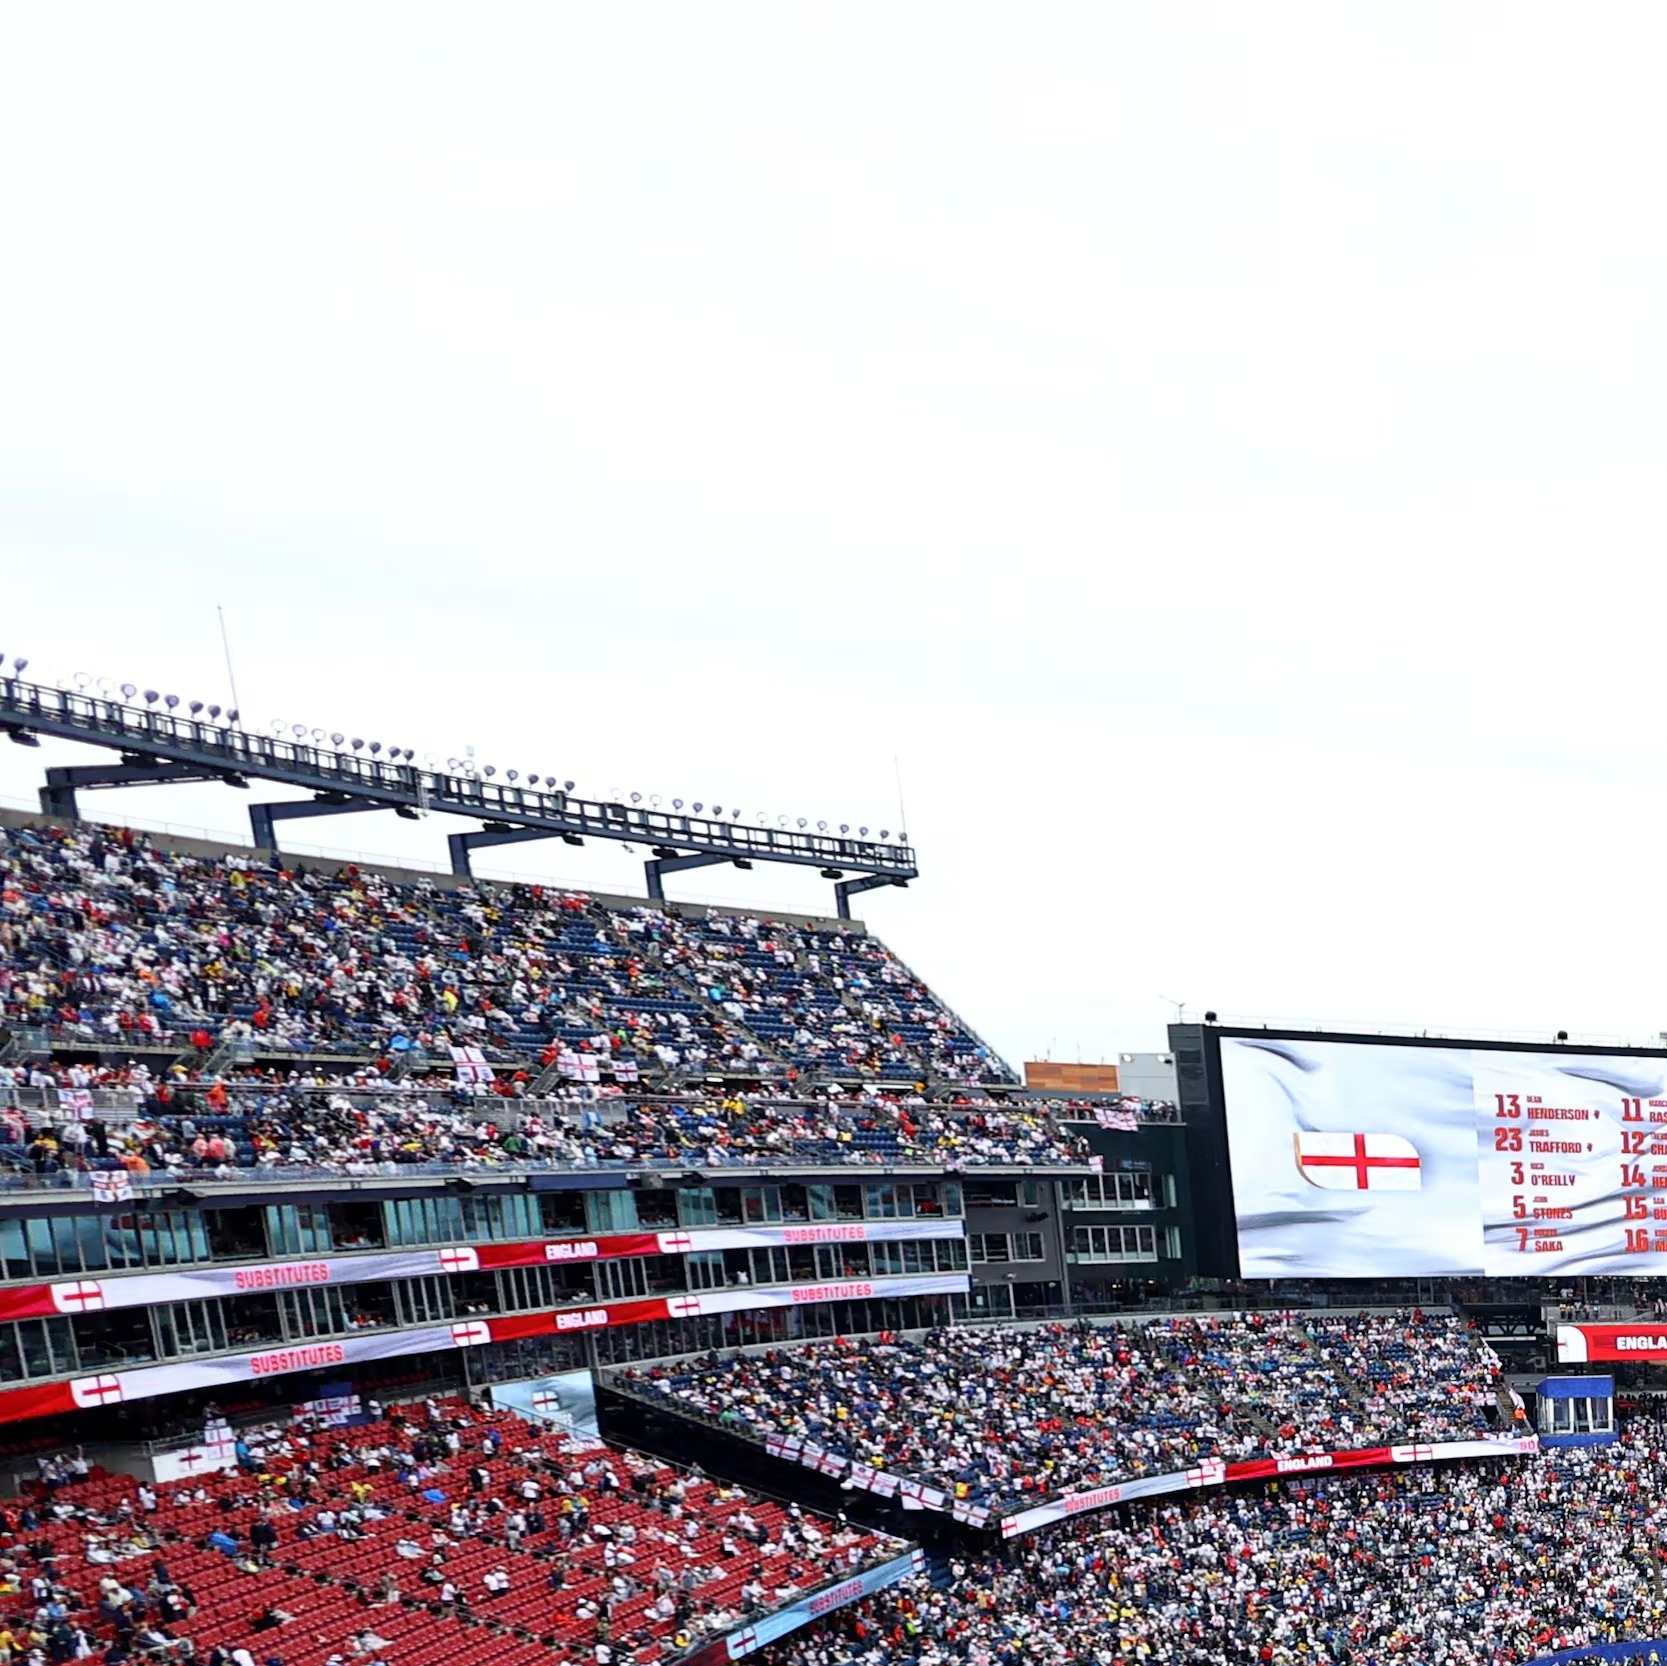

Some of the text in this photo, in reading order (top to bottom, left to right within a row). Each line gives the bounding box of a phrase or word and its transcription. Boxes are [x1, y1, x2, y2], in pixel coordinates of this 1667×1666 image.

[1496, 1094, 1522, 1119] 13
[1527, 1107, 1589, 1120] HENDERSON
[1622, 1098, 1645, 1122] 11
[1493, 1126, 1524, 1153] 23
[1530, 1140, 1582, 1154] TRAFFORD
[1621, 1130, 1646, 1156] 12
[1511, 1161, 1525, 1185] 3
[1620, 1163, 1647, 1187] 14
[1513, 1194, 1528, 1220] 5
[1532, 1207, 1574, 1220] STONES
[1622, 1195, 1649, 1221] 15
[784, 1227, 865, 1242] SUBSTITUTES
[1514, 1226, 1530, 1252] 7
[1535, 1239, 1564, 1253] SAKA
[1624, 1228, 1651, 1253] 16
[546, 1243, 597, 1260] ENGLAND
[234, 1264, 330, 1288] SUBSTITUTES
[792, 1284, 872, 1301] SUBSTITUTES
[556, 1310, 608, 1329] ENGLAND
[251, 1345, 344, 1374] SUBSTITUTES
[1278, 1456, 1333, 1472] ENGLAND
